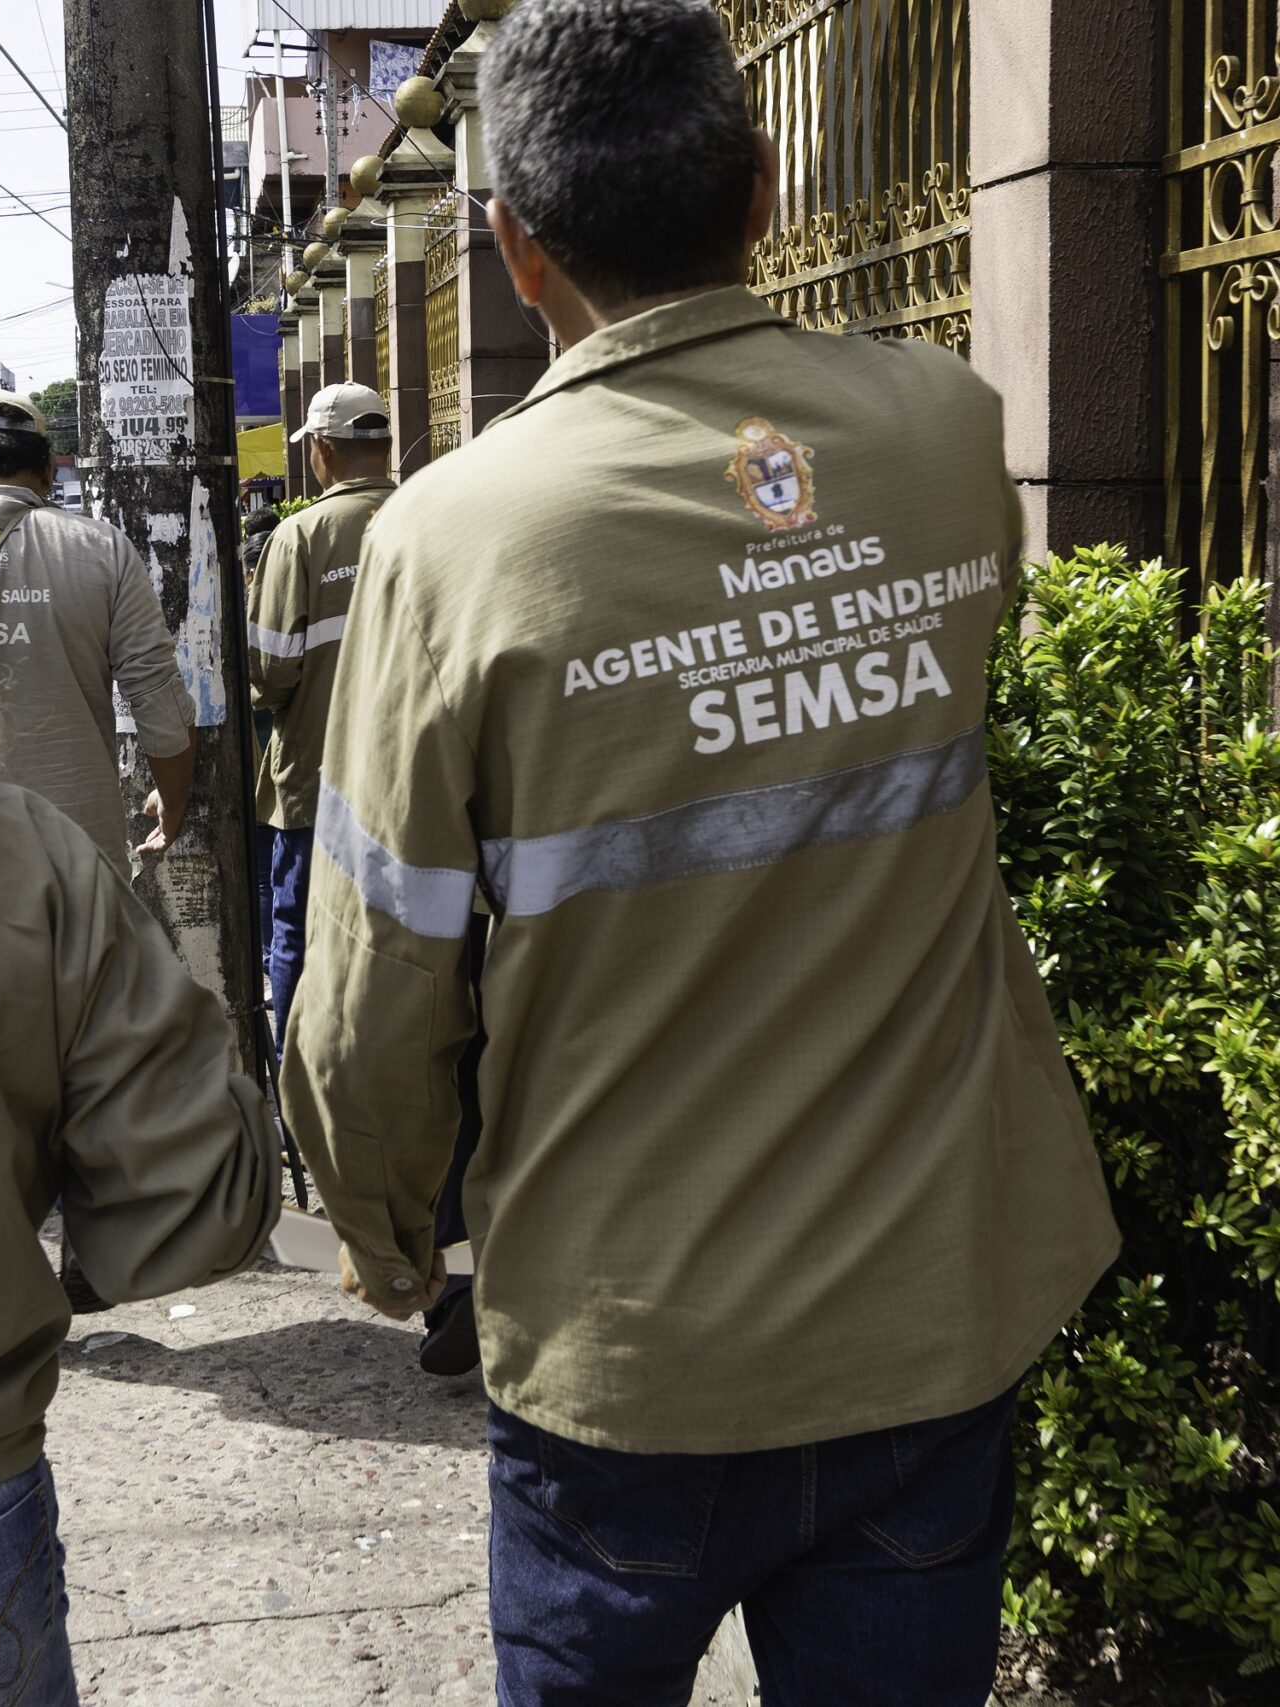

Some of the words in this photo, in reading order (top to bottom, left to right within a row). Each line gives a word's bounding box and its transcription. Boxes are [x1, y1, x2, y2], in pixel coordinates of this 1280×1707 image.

[152, 297, 182, 307] PARA
[169, 307, 188, 328] EM
[113, 358, 138, 383] SEXO
[140, 356, 188, 381] FEMININO
[130, 385, 157, 395] TEL:
[746, 528, 822, 555] Prefeitura
[826, 523, 845, 536] de
[719, 536, 885, 599] Manaus
[1, 584, 50, 604] SAÚDE
[564, 619, 747, 697] AGENTE
[759, 602, 821, 649] DE
[831, 551, 999, 631] ENDEMIAS
[678, 657, 774, 689] SECRETARIA
[776, 632, 866, 670] MUNICIPAL
[869, 625, 892, 643] DE
[893, 612, 943, 639] SAÚDE
[688, 639, 953, 756] SEMSA
